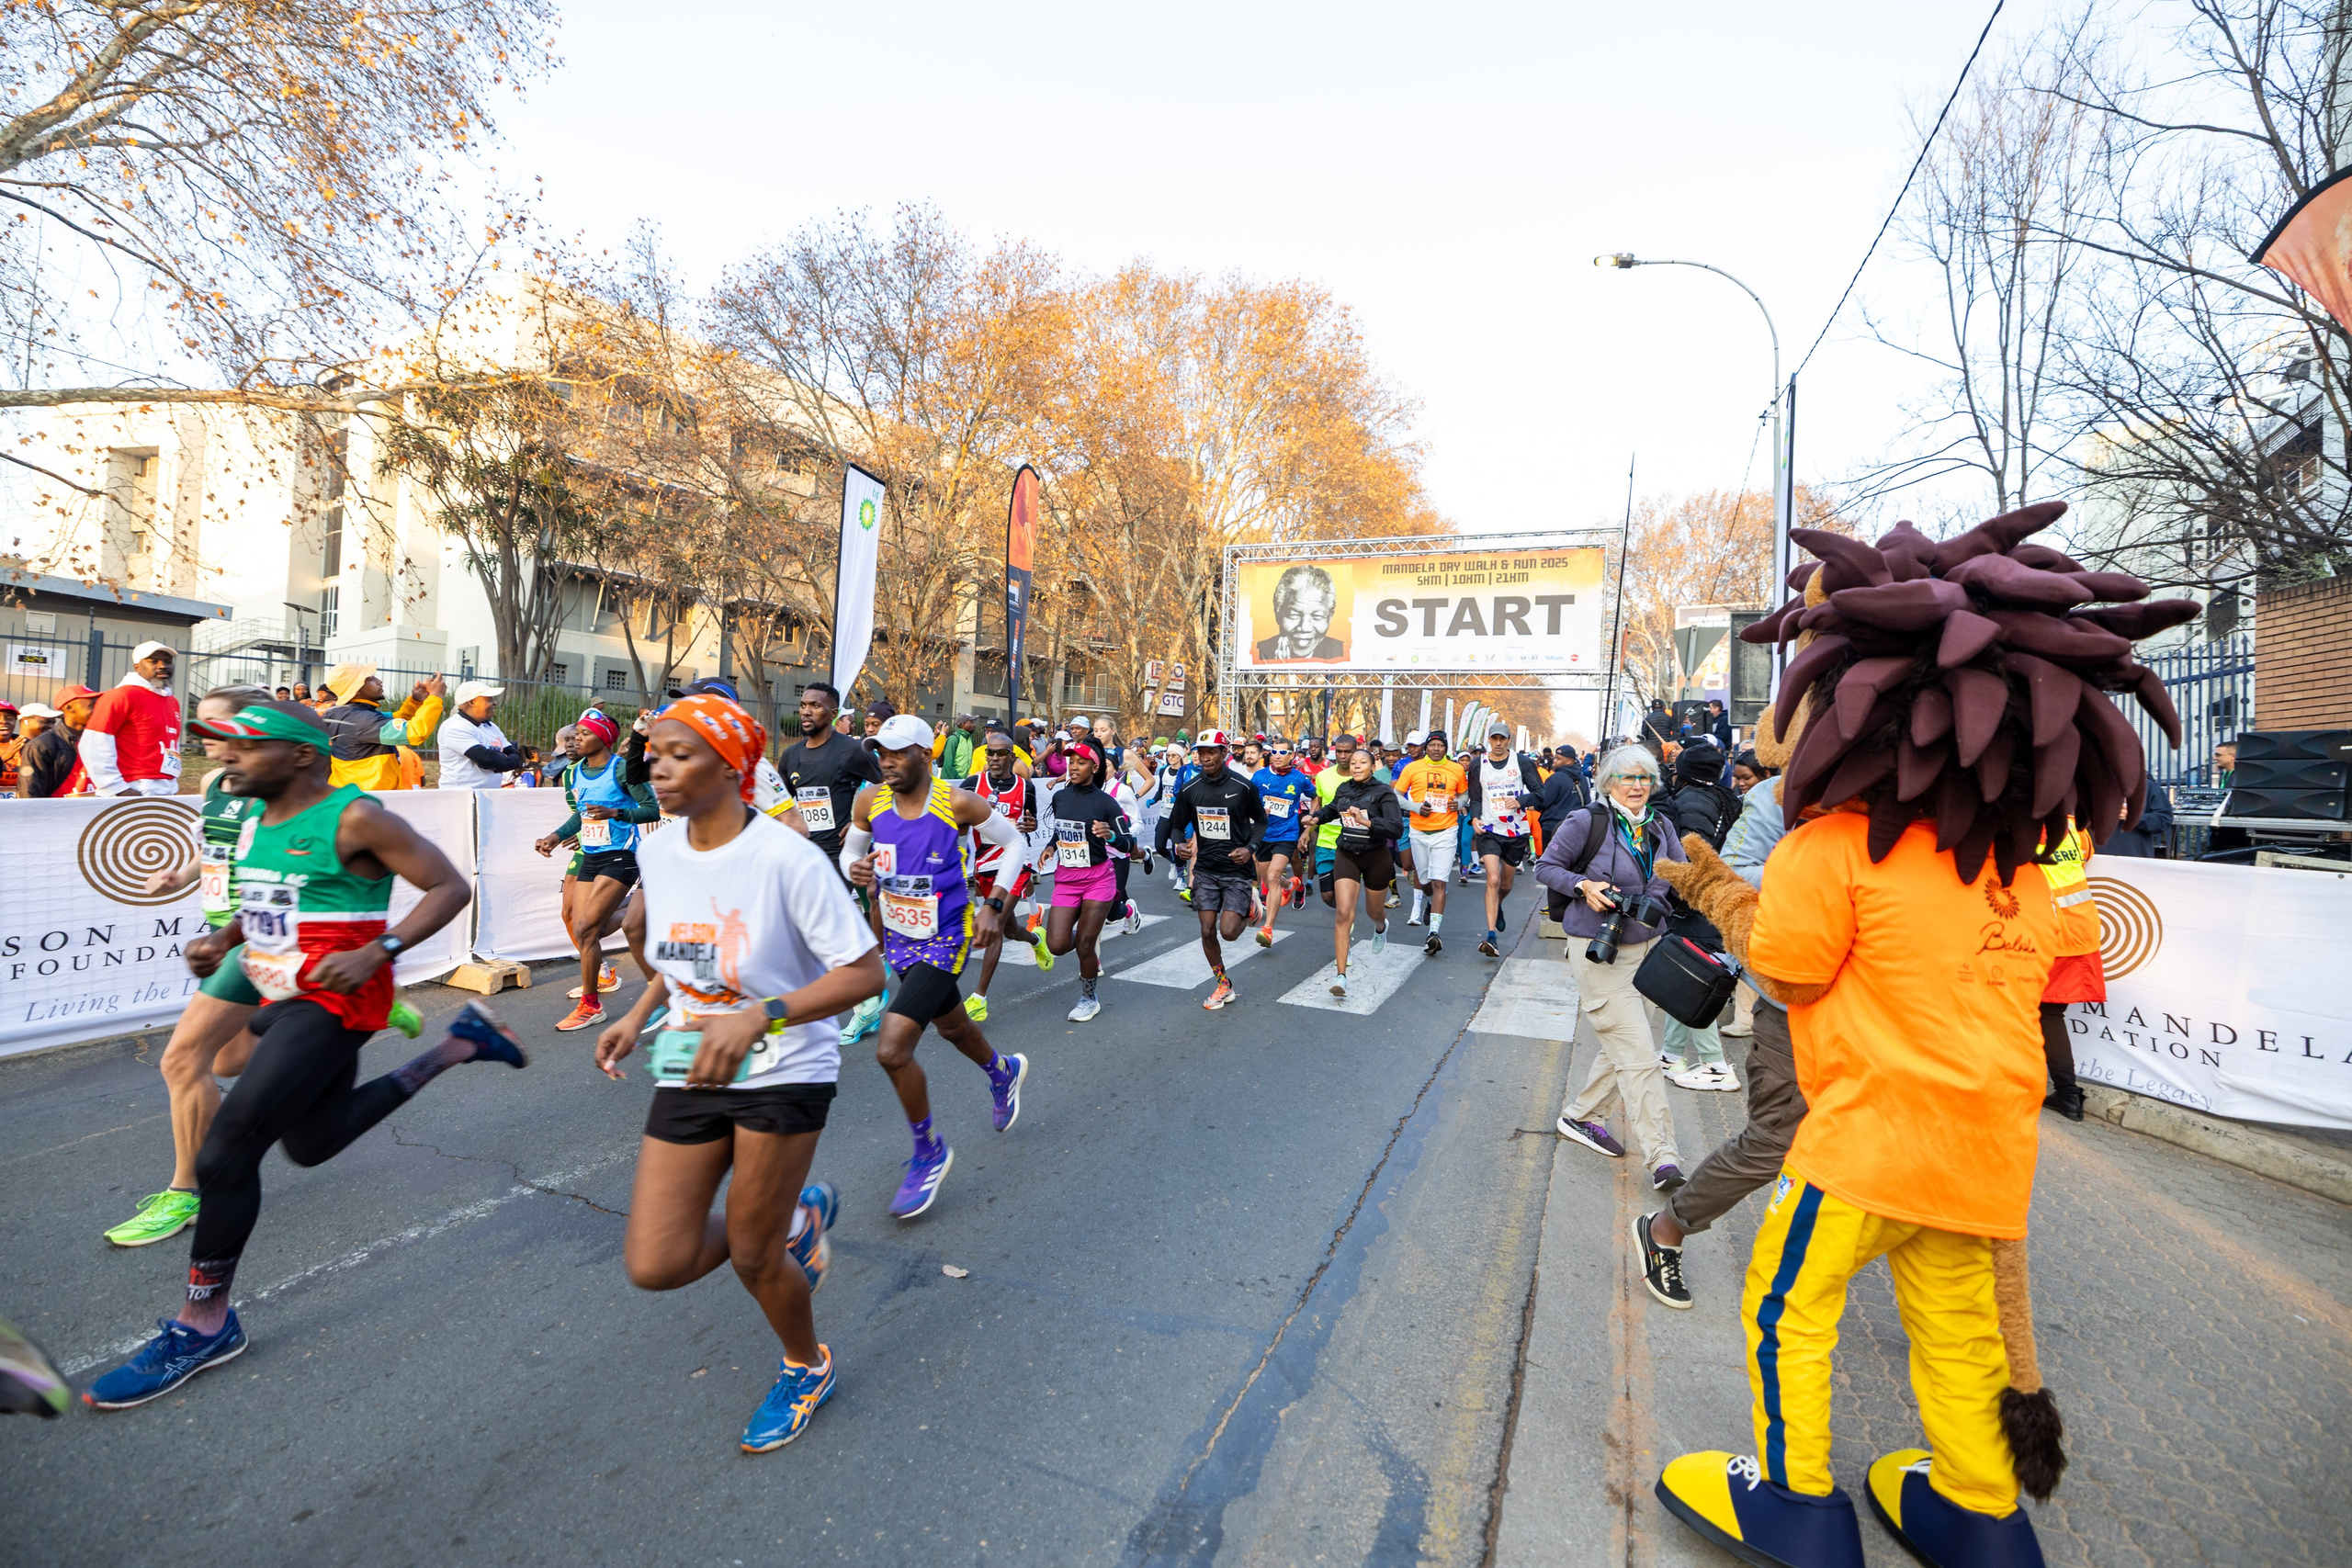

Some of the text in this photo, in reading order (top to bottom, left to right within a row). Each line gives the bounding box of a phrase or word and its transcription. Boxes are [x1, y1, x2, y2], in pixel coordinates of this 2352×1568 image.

[1383, 558, 1568, 574] MANDELA DAY WALK & RUN 2025
[1417, 575, 1442, 585] 5KM
[1452, 573, 1485, 584] 10KM
[1496, 572, 1529, 583] 21KM
[1374, 594, 1576, 637] START
[1162, 694, 1184, 708] GTC
[1507, 769, 1518, 777] 55
[1270, 802, 1285, 812] 207
[1201, 821, 1227, 832] 1244
[1060, 849, 1087, 860] 1314
[886, 903, 933, 927] 3635
[10, 942, 182, 980] FOUNDA
[24, 994, 120, 1022] Living
[132, 981, 172, 1004] the
[2068, 1018, 2222, 1068] DATION
[2078, 1057, 2213, 1112] the Legacy
